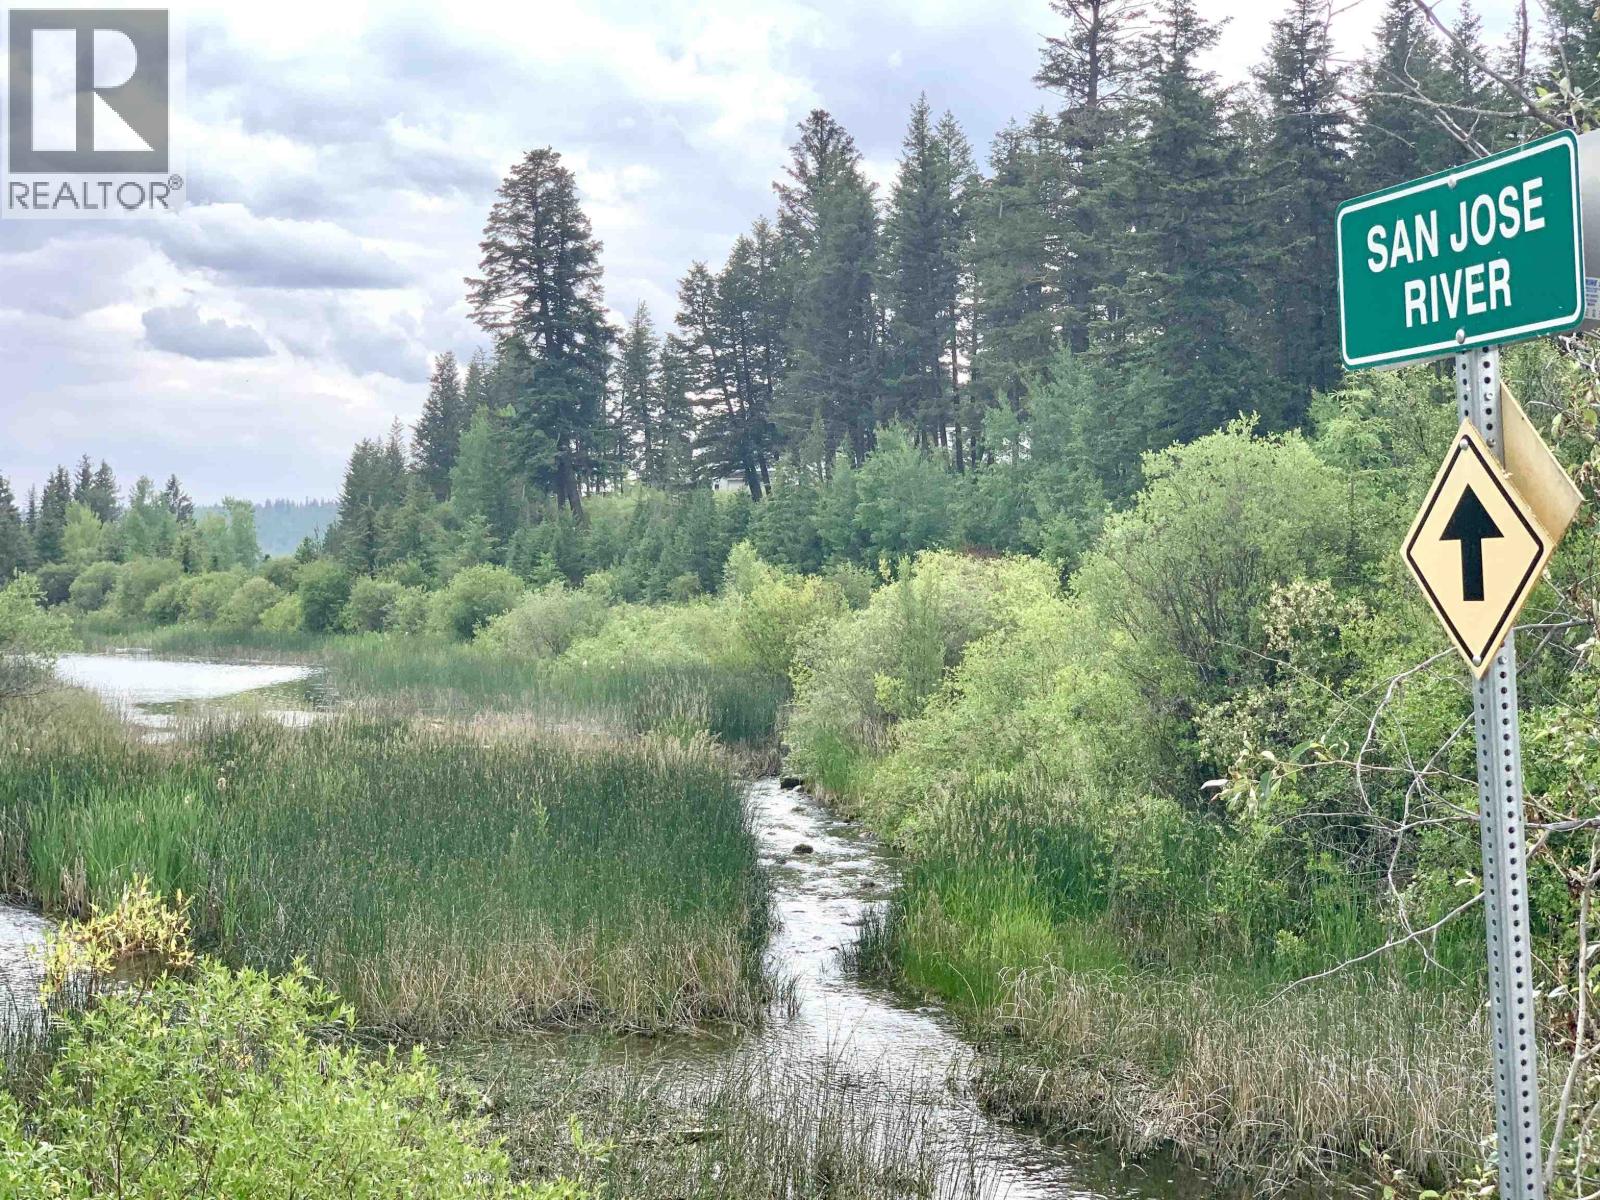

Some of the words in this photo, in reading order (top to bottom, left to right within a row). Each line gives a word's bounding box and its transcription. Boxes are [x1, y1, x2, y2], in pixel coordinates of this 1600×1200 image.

[1366, 210, 1439, 273] SAN
[1450, 177, 1546, 253] JOSE
[1404, 258, 1512, 328] RIVER
